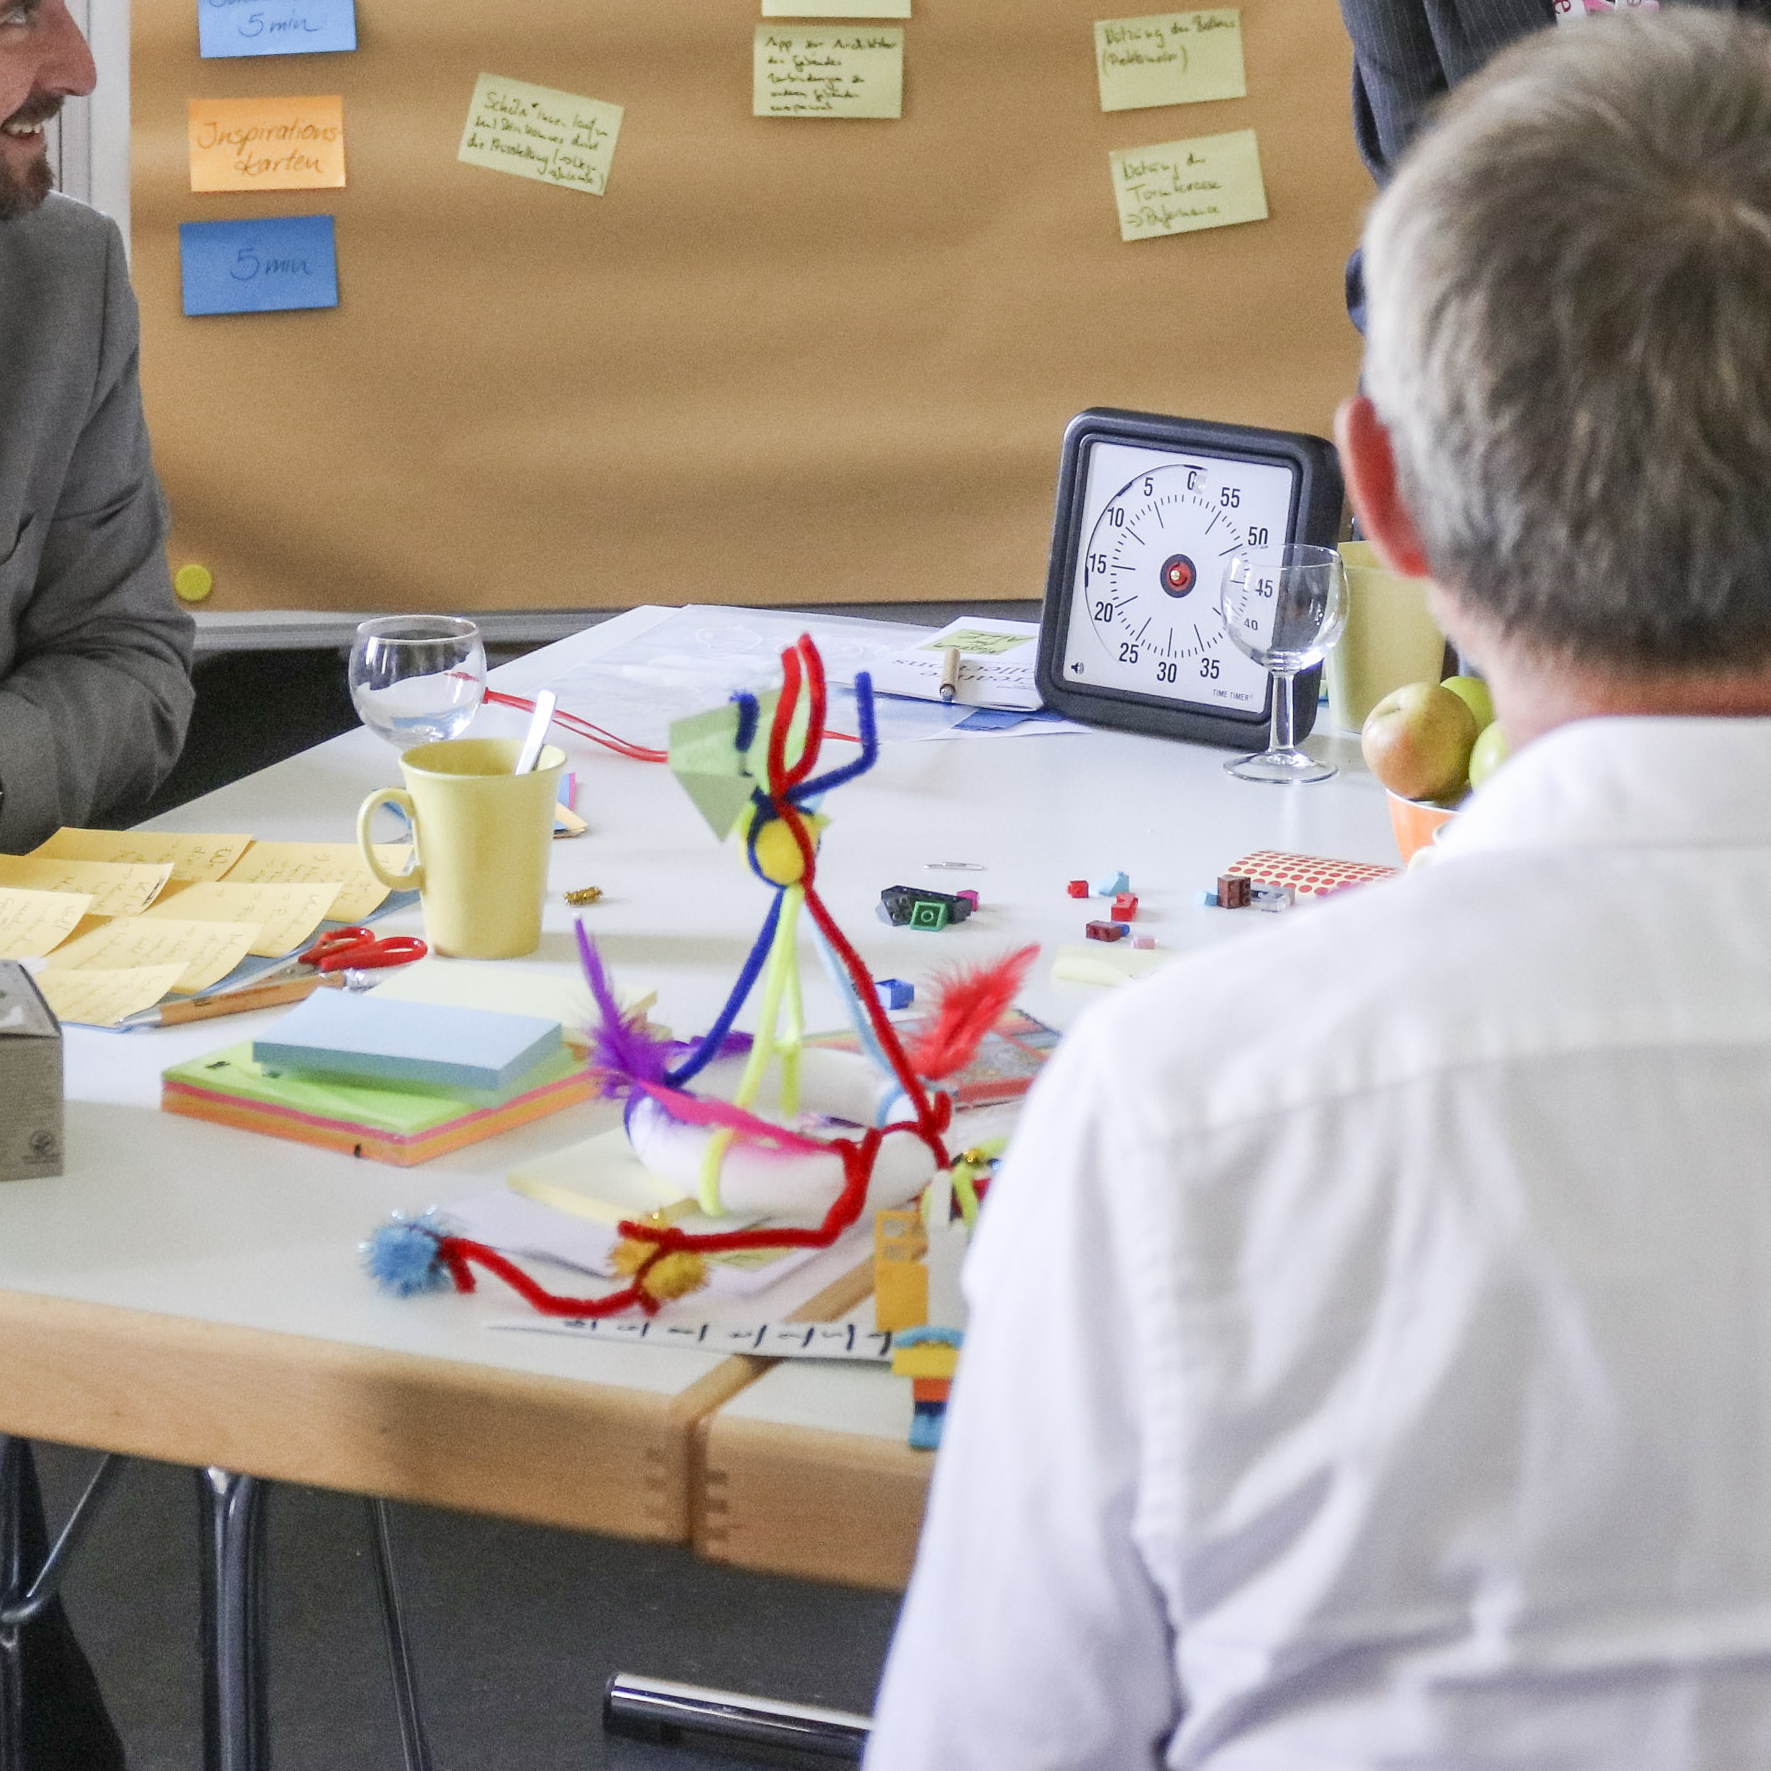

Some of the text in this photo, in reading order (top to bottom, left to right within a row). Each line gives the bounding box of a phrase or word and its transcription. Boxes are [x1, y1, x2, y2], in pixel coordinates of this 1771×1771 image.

[237, 9, 324, 39] 5 min
[228, 248, 311, 283] 5 min
[1143, 477, 1154, 497] 5
[1220, 487, 1241, 509] 55
[1107, 507, 1125, 528] 10
[1247, 526, 1269, 548] 50
[1089, 554, 1107, 575] 15
[1255, 579, 1274, 598] 45
[1094, 602, 1113, 623] 20
[1119, 642, 1140, 665] 25
[1156, 661, 1178, 684] 30
[1199, 658, 1221, 680] 35
[1213, 688, 1228, 699] TIME
